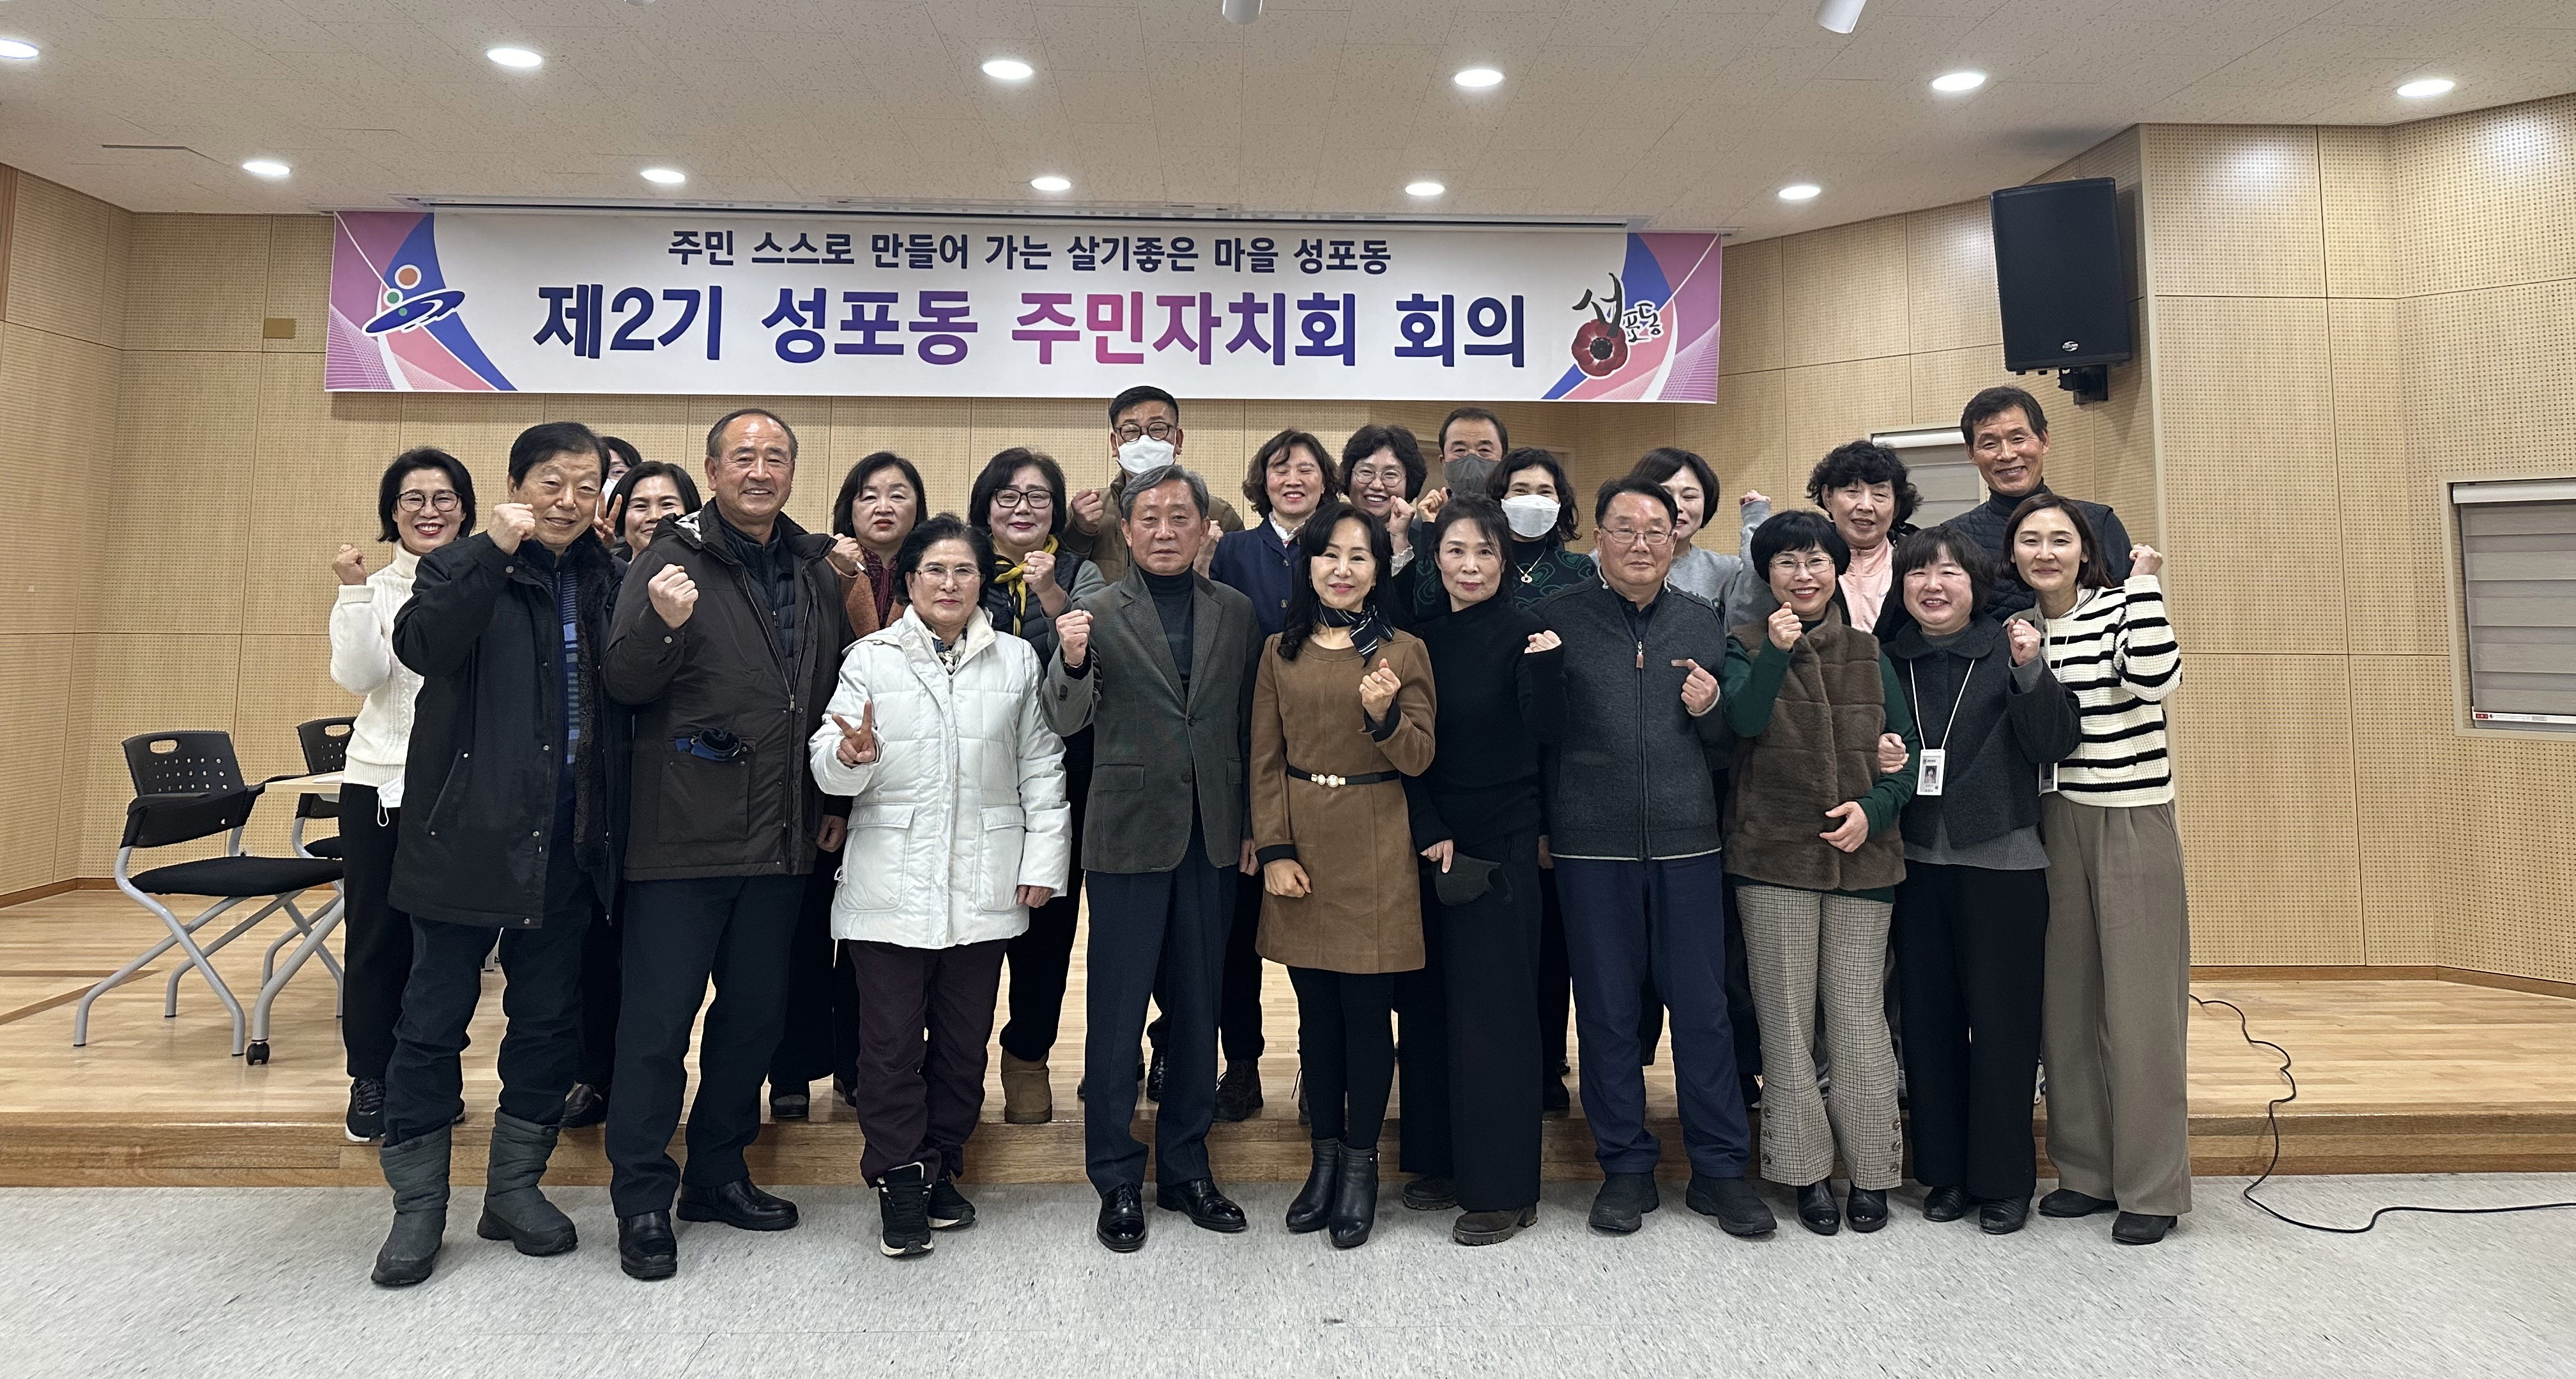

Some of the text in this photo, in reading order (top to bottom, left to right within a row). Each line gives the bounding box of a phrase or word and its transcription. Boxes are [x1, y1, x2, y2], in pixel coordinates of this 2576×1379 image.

[668, 230, 1392, 275] 주민 스스로 만들어 가는 살기좋은 마을 성포동
[533, 284, 1525, 368] 제2기 성포동 주민자치회 회의
